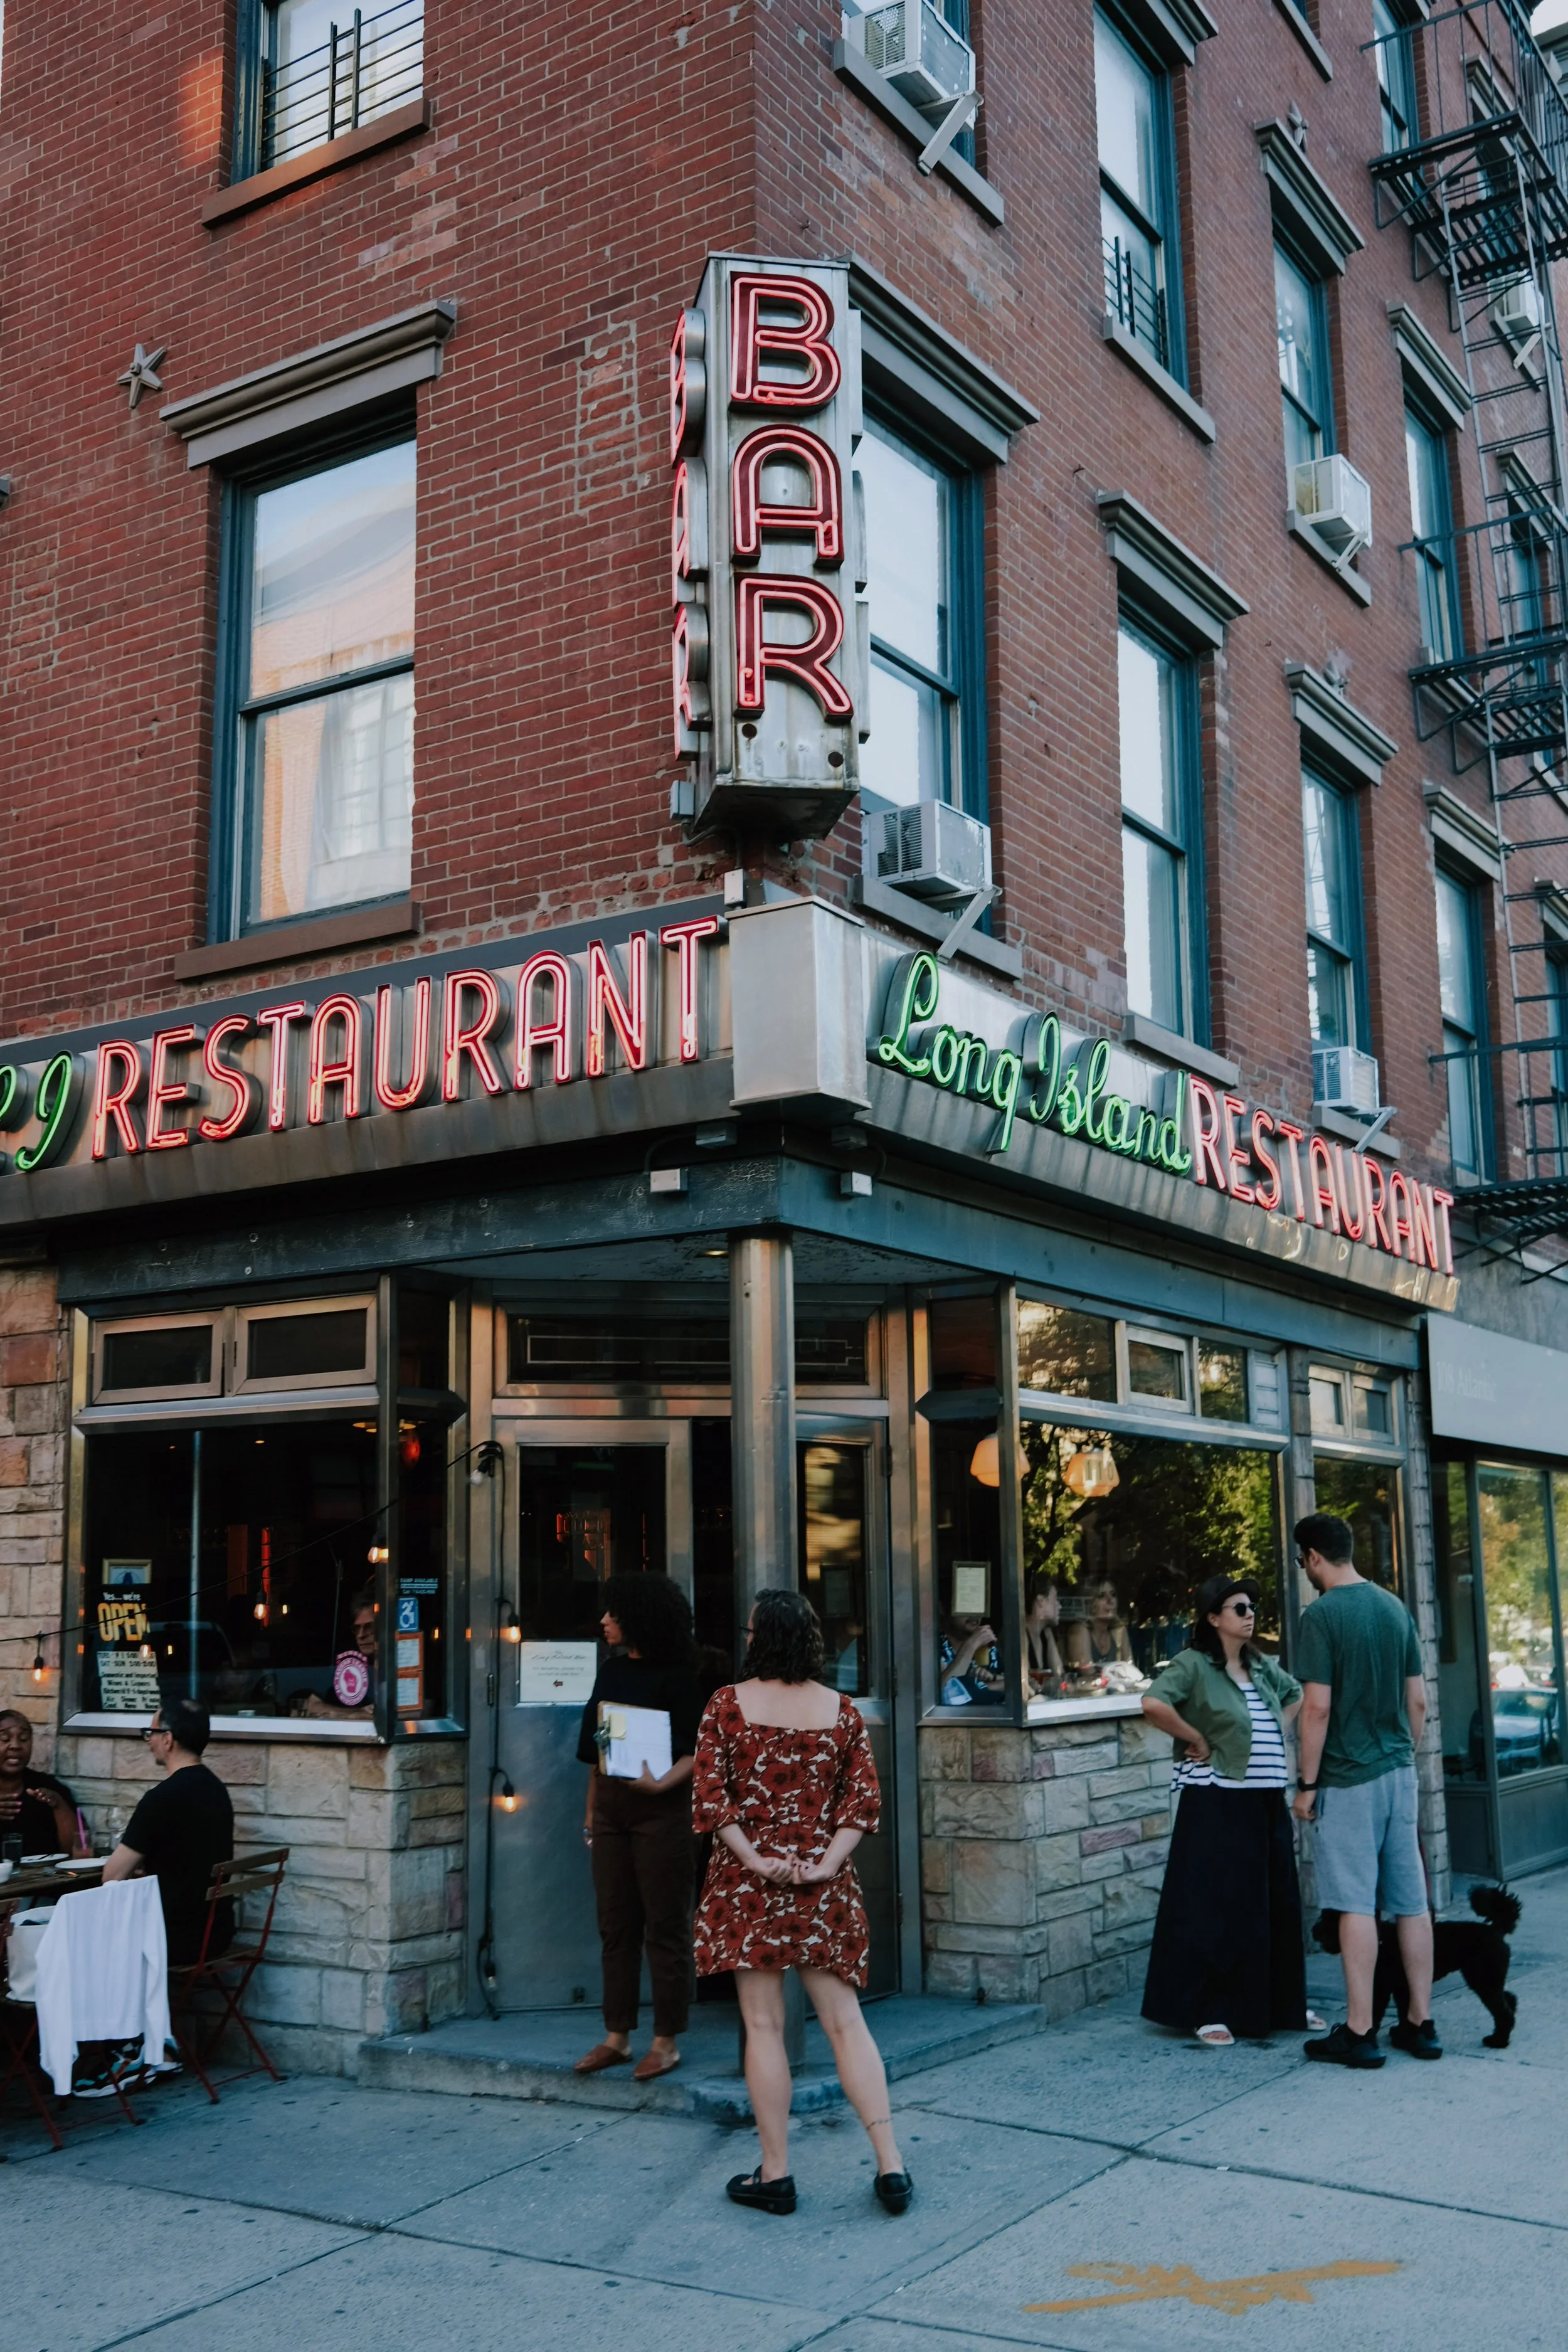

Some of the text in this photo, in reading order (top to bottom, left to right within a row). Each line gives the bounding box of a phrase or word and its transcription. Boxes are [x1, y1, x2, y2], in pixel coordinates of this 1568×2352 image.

[729, 271, 854, 721] BAR
[91, 914, 721, 1160] RESTAURANT
[878, 951, 1454, 1274] Long Island RESTAURANT
[97, 1602, 151, 1641] OPEN
